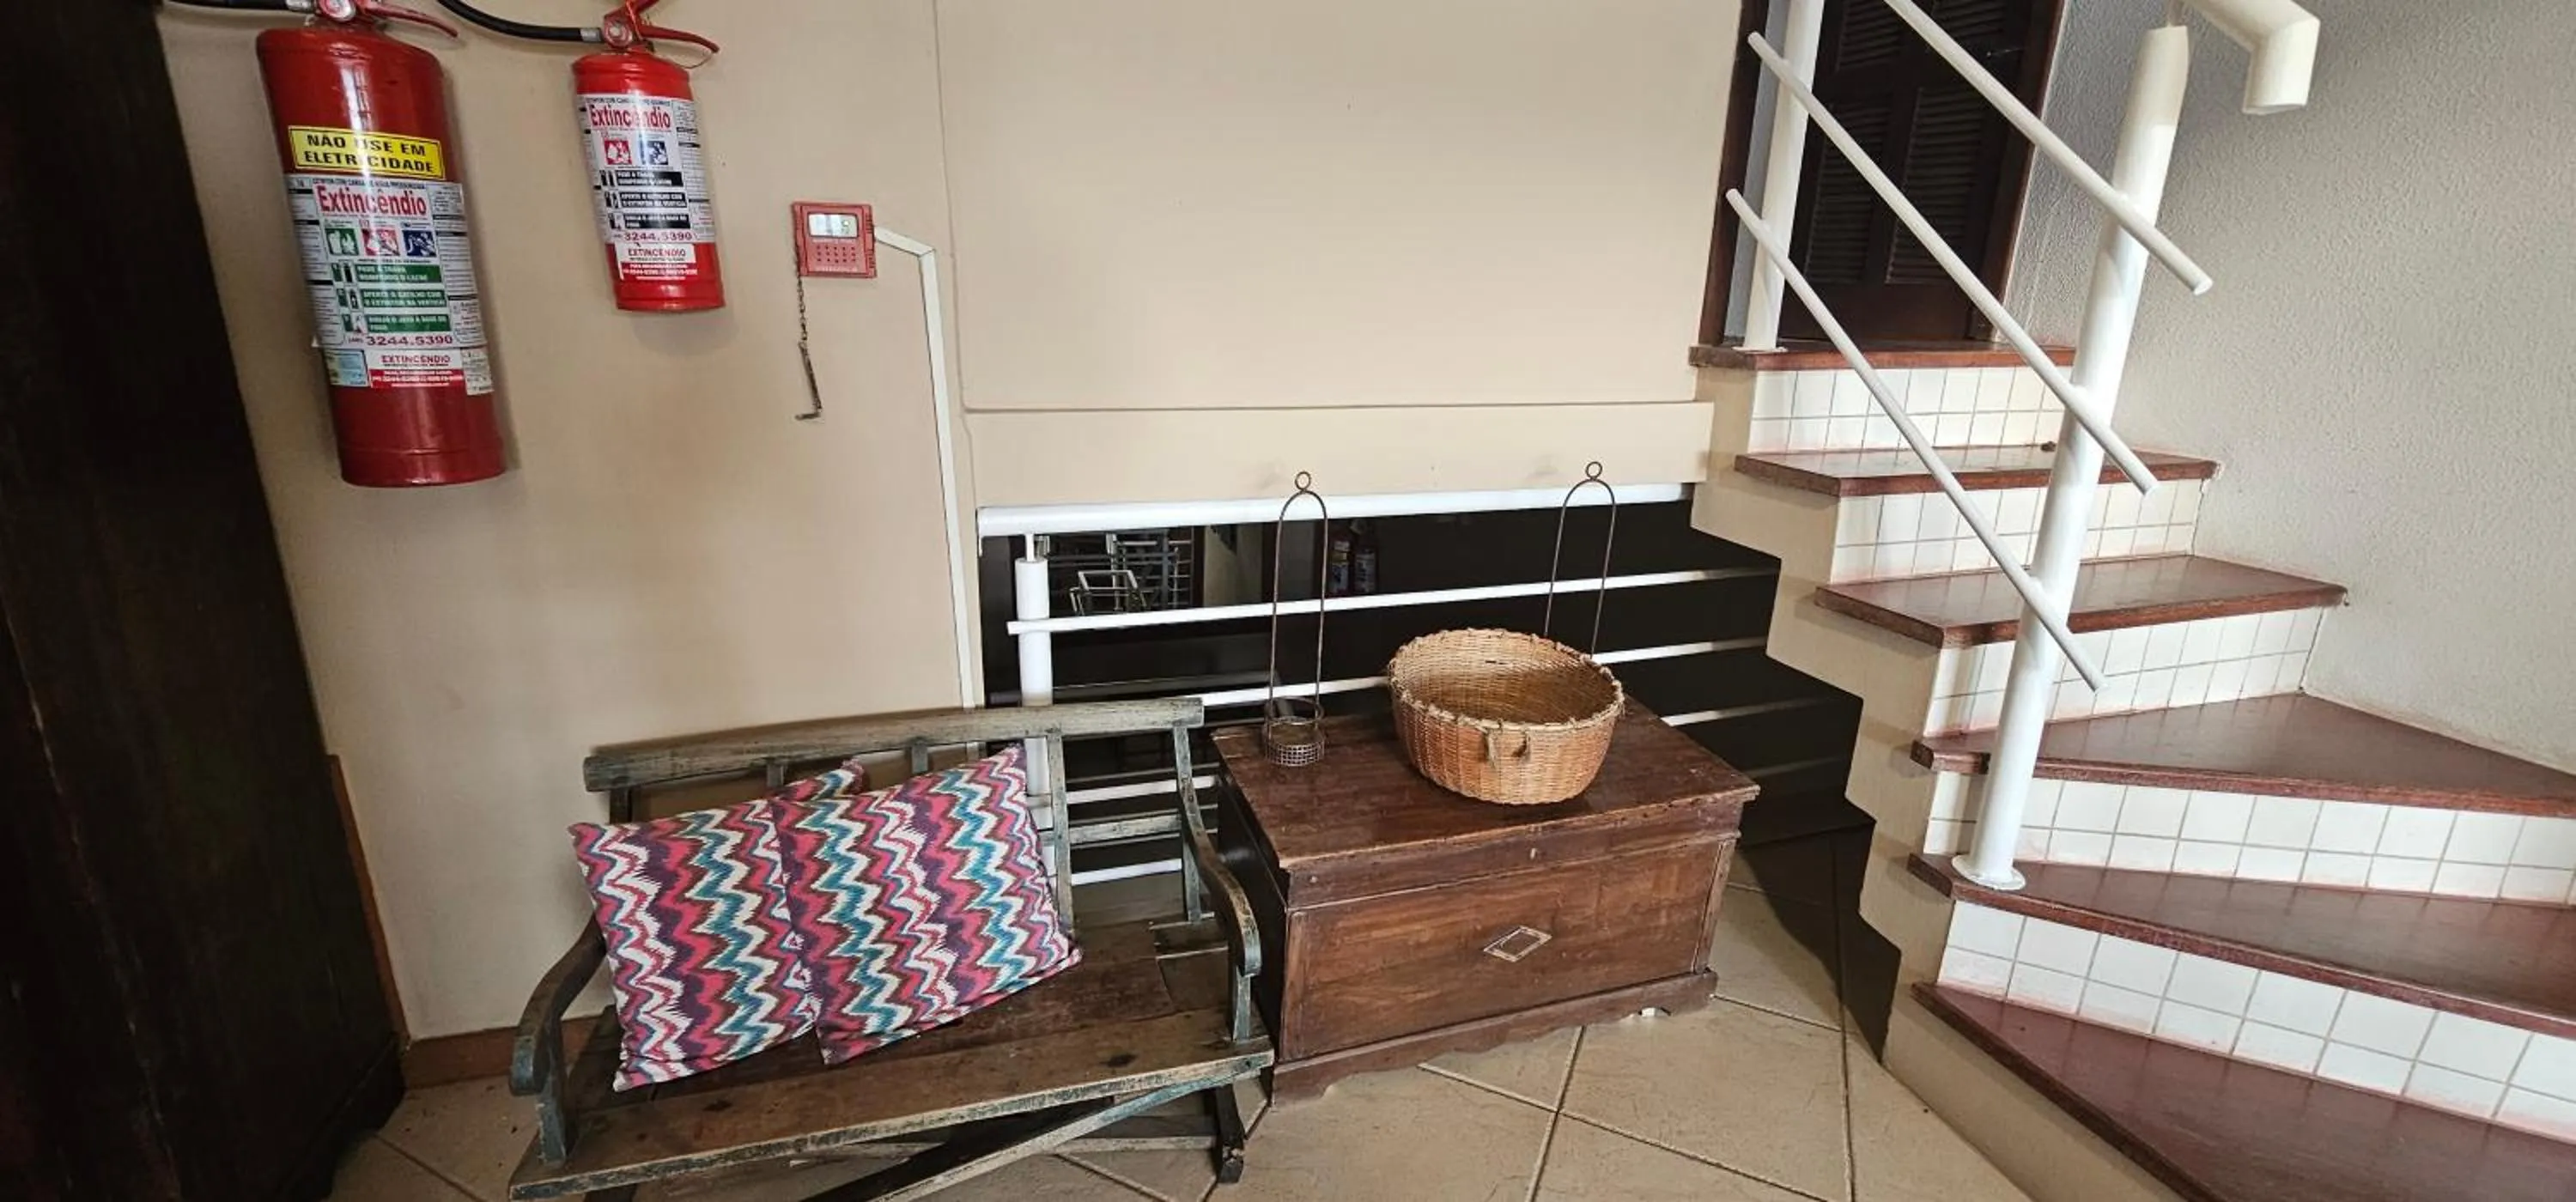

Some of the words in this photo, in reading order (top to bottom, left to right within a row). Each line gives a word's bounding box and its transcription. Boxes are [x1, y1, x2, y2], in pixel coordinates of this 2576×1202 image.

[307, 133, 347, 149] NÃO
[400, 143, 427, 157] EM
[303, 150, 435, 173] ELETRCIDADE
[366, 334, 454, 346] 3244.5390
